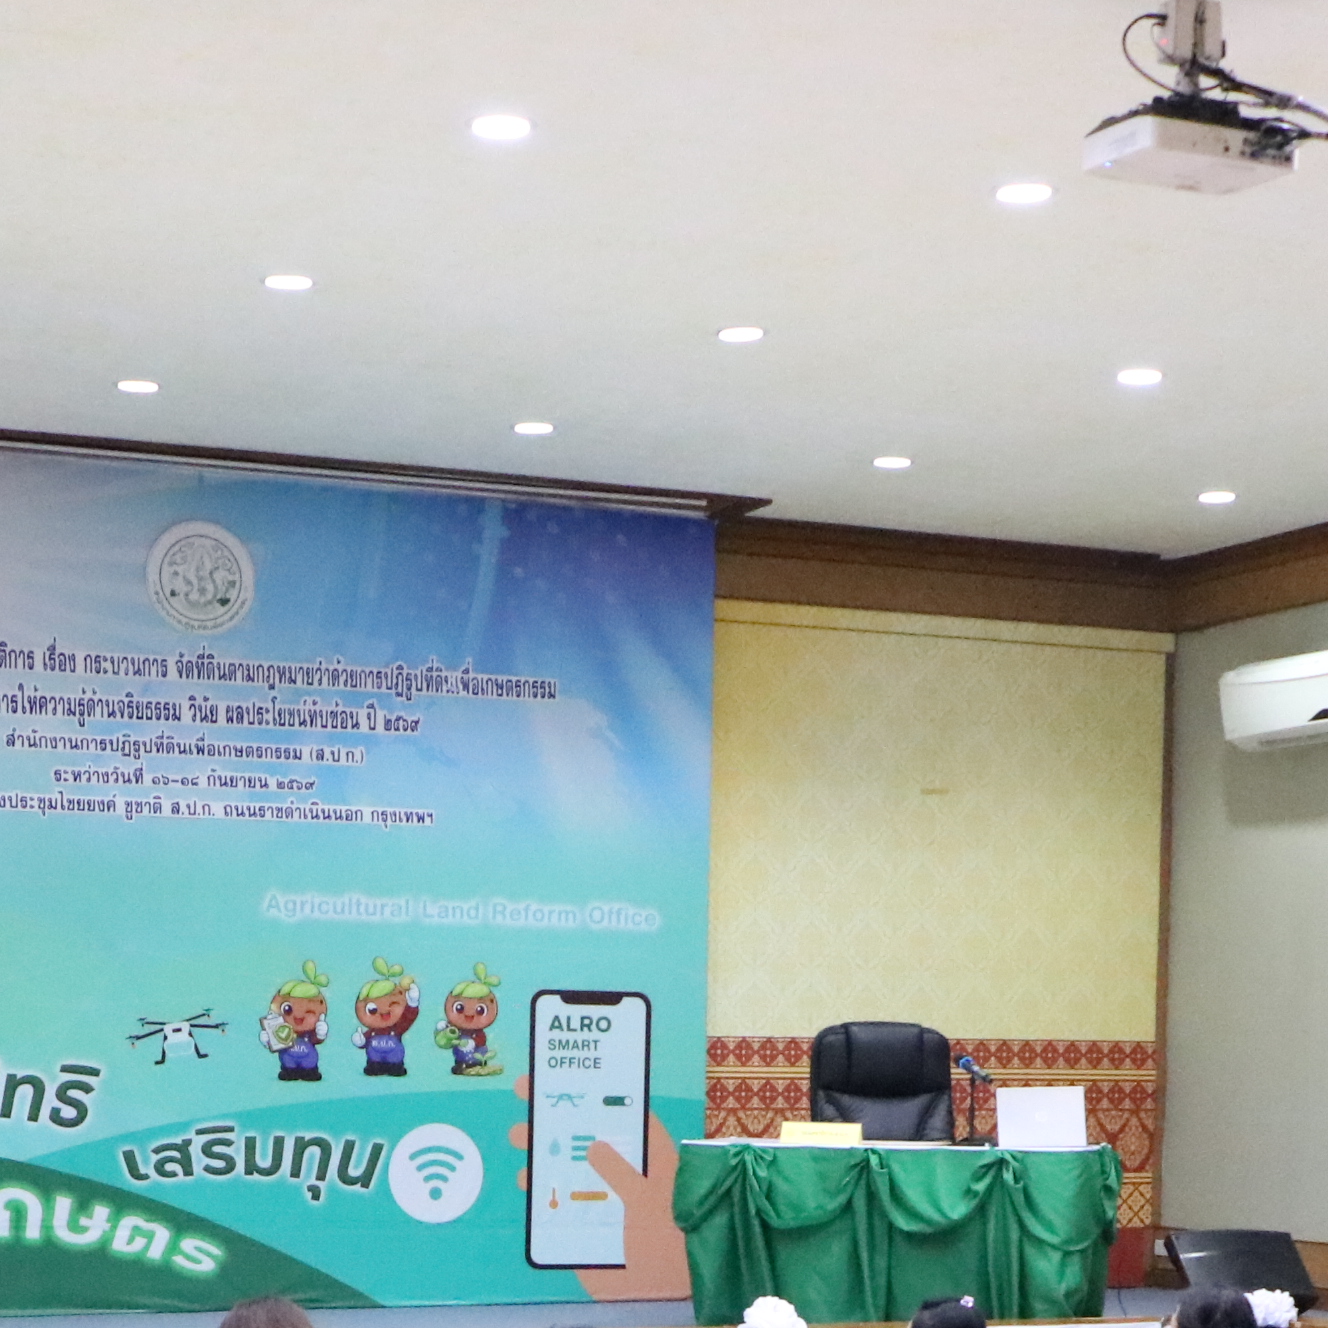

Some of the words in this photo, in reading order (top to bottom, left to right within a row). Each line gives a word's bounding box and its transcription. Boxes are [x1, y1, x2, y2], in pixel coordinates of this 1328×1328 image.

[43, 637, 77, 674] เรื่อง
[83, 653, 168, 679] กระบวนการ
[189, 695, 219, 725] วินัย
[225, 696, 360, 731] ผลประโยชน์ทับซ้อน
[367, 702, 377, 731] ปี
[5, 728, 303, 761] สำนักงานการปฏิรูปที่ดินเพื่อเกษตรกรรม
[309, 747, 364, 765] (ส.ปก.)
[53, 762, 144, 786] ระหว่างวันที่
[206, 768, 269, 789] กันยายน
[170, 799, 215, 817] ส.ป.ก.
[223, 800, 364, 823] ถนนราชดำเนินนอก
[370, 808, 434, 829] กรุงเทพฯ
[265, 893, 410, 919] Agricultural
[422, 899, 481, 921] Land
[491, 901, 577, 926] Reform
[588, 905, 659, 929] Office
[548, 1014, 612, 1034] ALRO
[547, 1038, 601, 1052] SMART
[547, 1056, 602, 1070] OFFICE
[121, 1125, 385, 1202] เสริมทุน
